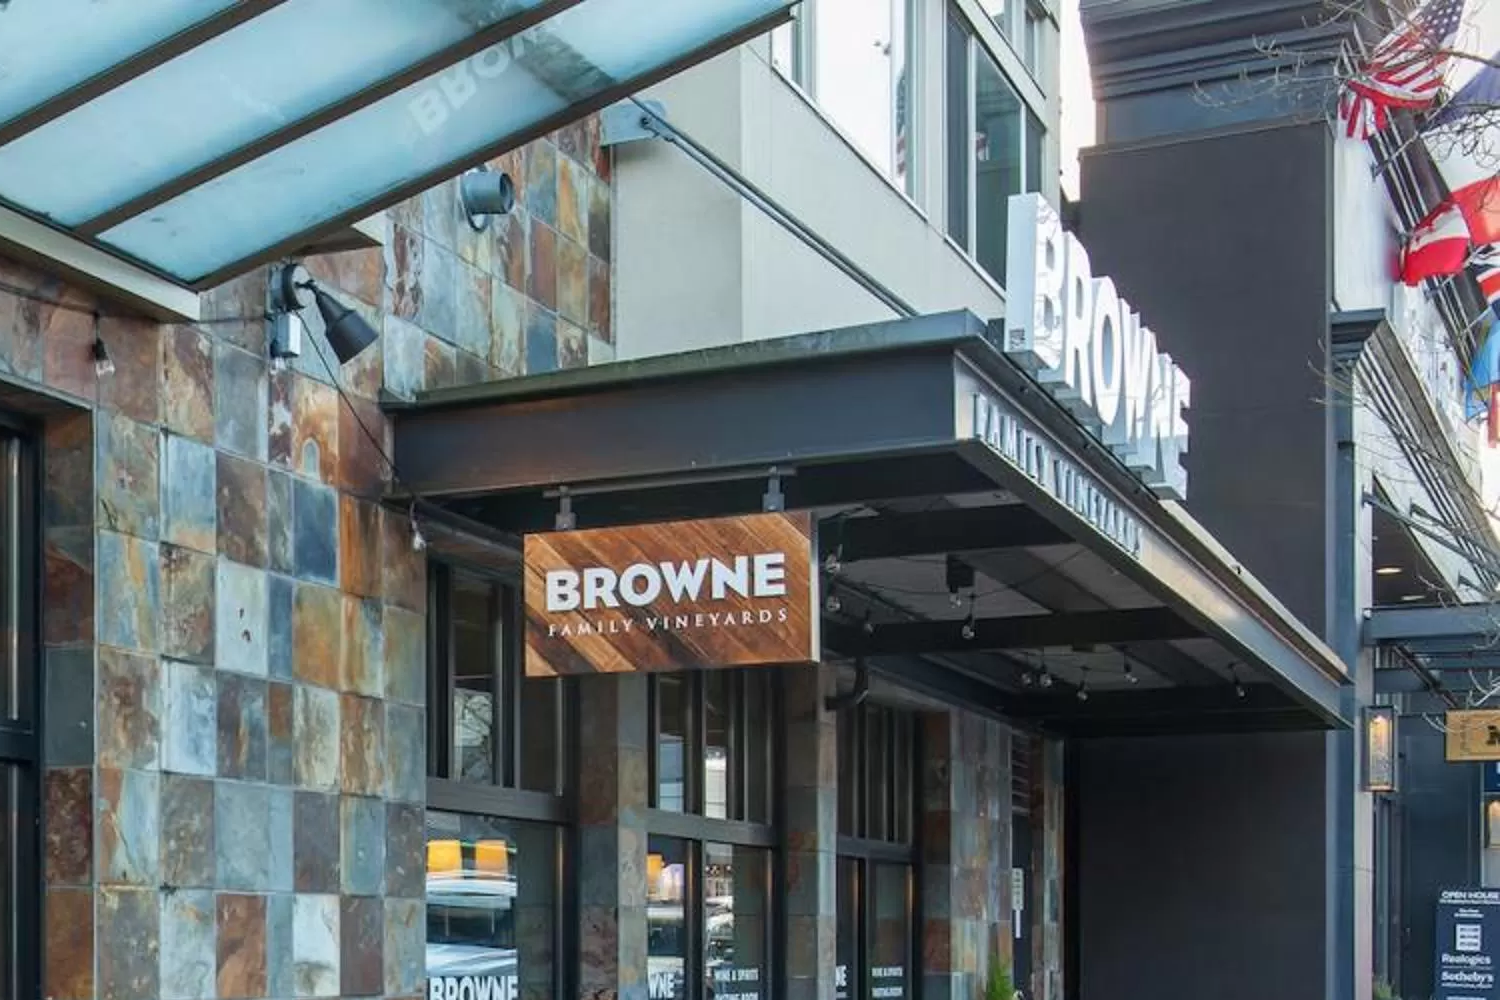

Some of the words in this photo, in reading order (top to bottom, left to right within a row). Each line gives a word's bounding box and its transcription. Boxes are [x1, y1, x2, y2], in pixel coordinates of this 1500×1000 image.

[1004, 191, 1191, 501] BROWNE
[546, 553, 786, 612] BROWNE
[548, 619, 634, 637] FAMILY
[647, 608, 789, 631] VINEYARDS
[1441, 891, 1466, 899] OPEN
[1441, 953, 1492, 967] Realogics
[1441, 971, 1494, 985] Sotheby's
